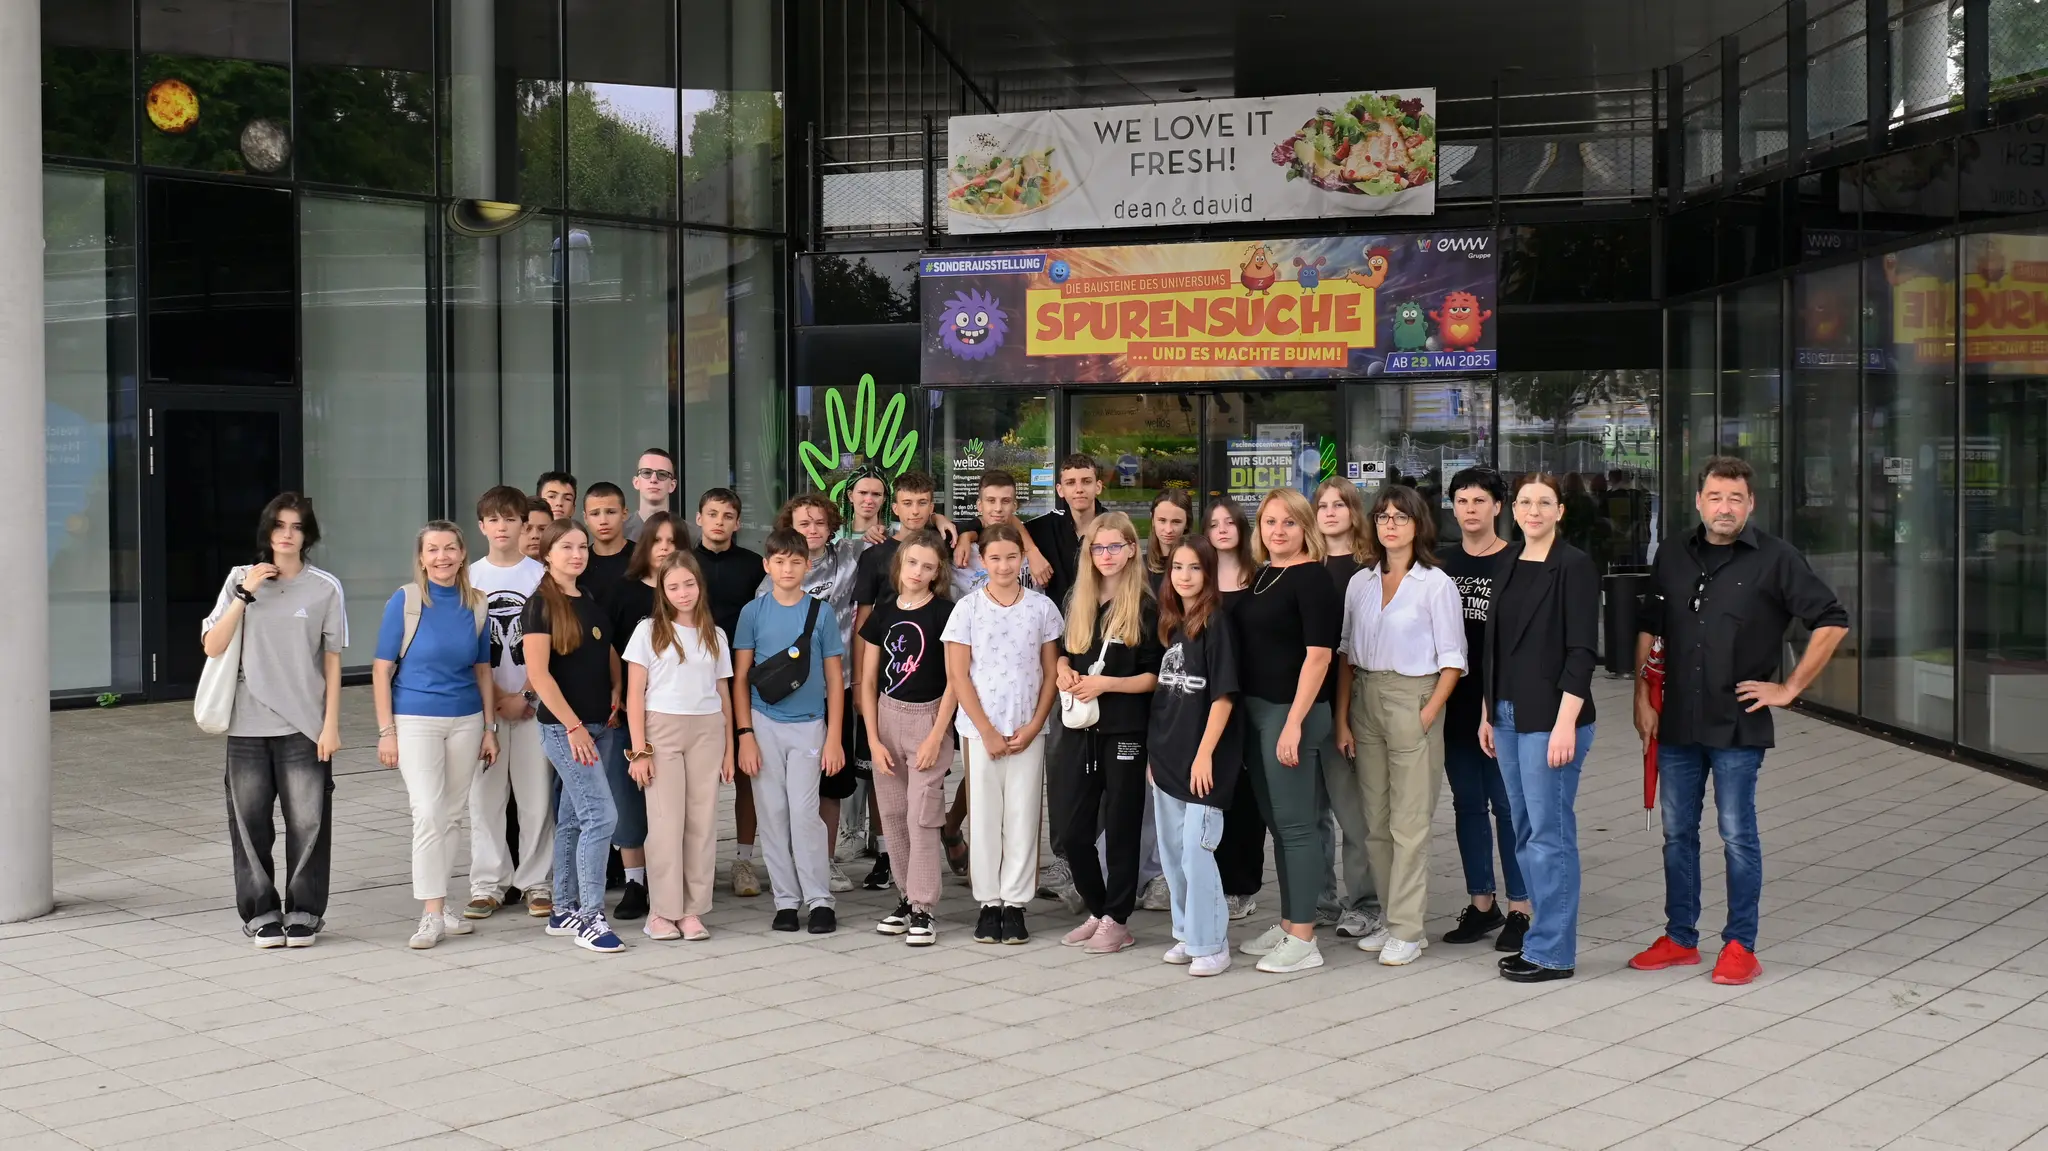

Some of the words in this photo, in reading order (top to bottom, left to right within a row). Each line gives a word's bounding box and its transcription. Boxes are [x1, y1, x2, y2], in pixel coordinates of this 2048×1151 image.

[1093, 118, 1142, 144] WE
[1154, 112, 1234, 142] LOVE
[1247, 111, 1273, 137] IT
[1130, 147, 1236, 177] FRESH!
[1467, 252, 1491, 260] Gruppe
[925, 257, 1040, 273] #SONDERAUSSTELLUNG
[1065, 283, 1082, 295] DIE
[1083, 280, 1136, 294] BAUSTEINE
[1139, 278, 1159, 290] DES
[1161, 274, 1226, 289] UNIVERSUMS
[1035, 292, 1362, 341] SPURENSUCHE
[1152, 347, 1187, 361] UND
[1190, 347, 1211, 361] ES
[1214, 346, 1280, 361] MACHTE
[1284, 346, 1342, 361] BUMM!
[1392, 356, 1408, 368] AB
[1411, 356, 1432, 368] 29.
[1435, 355, 1456, 367] MAI
[1459, 354, 1490, 367] 2025
[953, 456, 985, 468] welios
[1231, 456, 1251, 466] WIR
[1252, 456, 1292, 465] SUCHEN
[953, 474, 981, 482] Öffnungszeit
[1230, 467, 1292, 487] DICH!
[1473, 586, 1492, 597] ME
[1466, 596, 1489, 611] TWO
[1463, 608, 1487, 621] TERS
